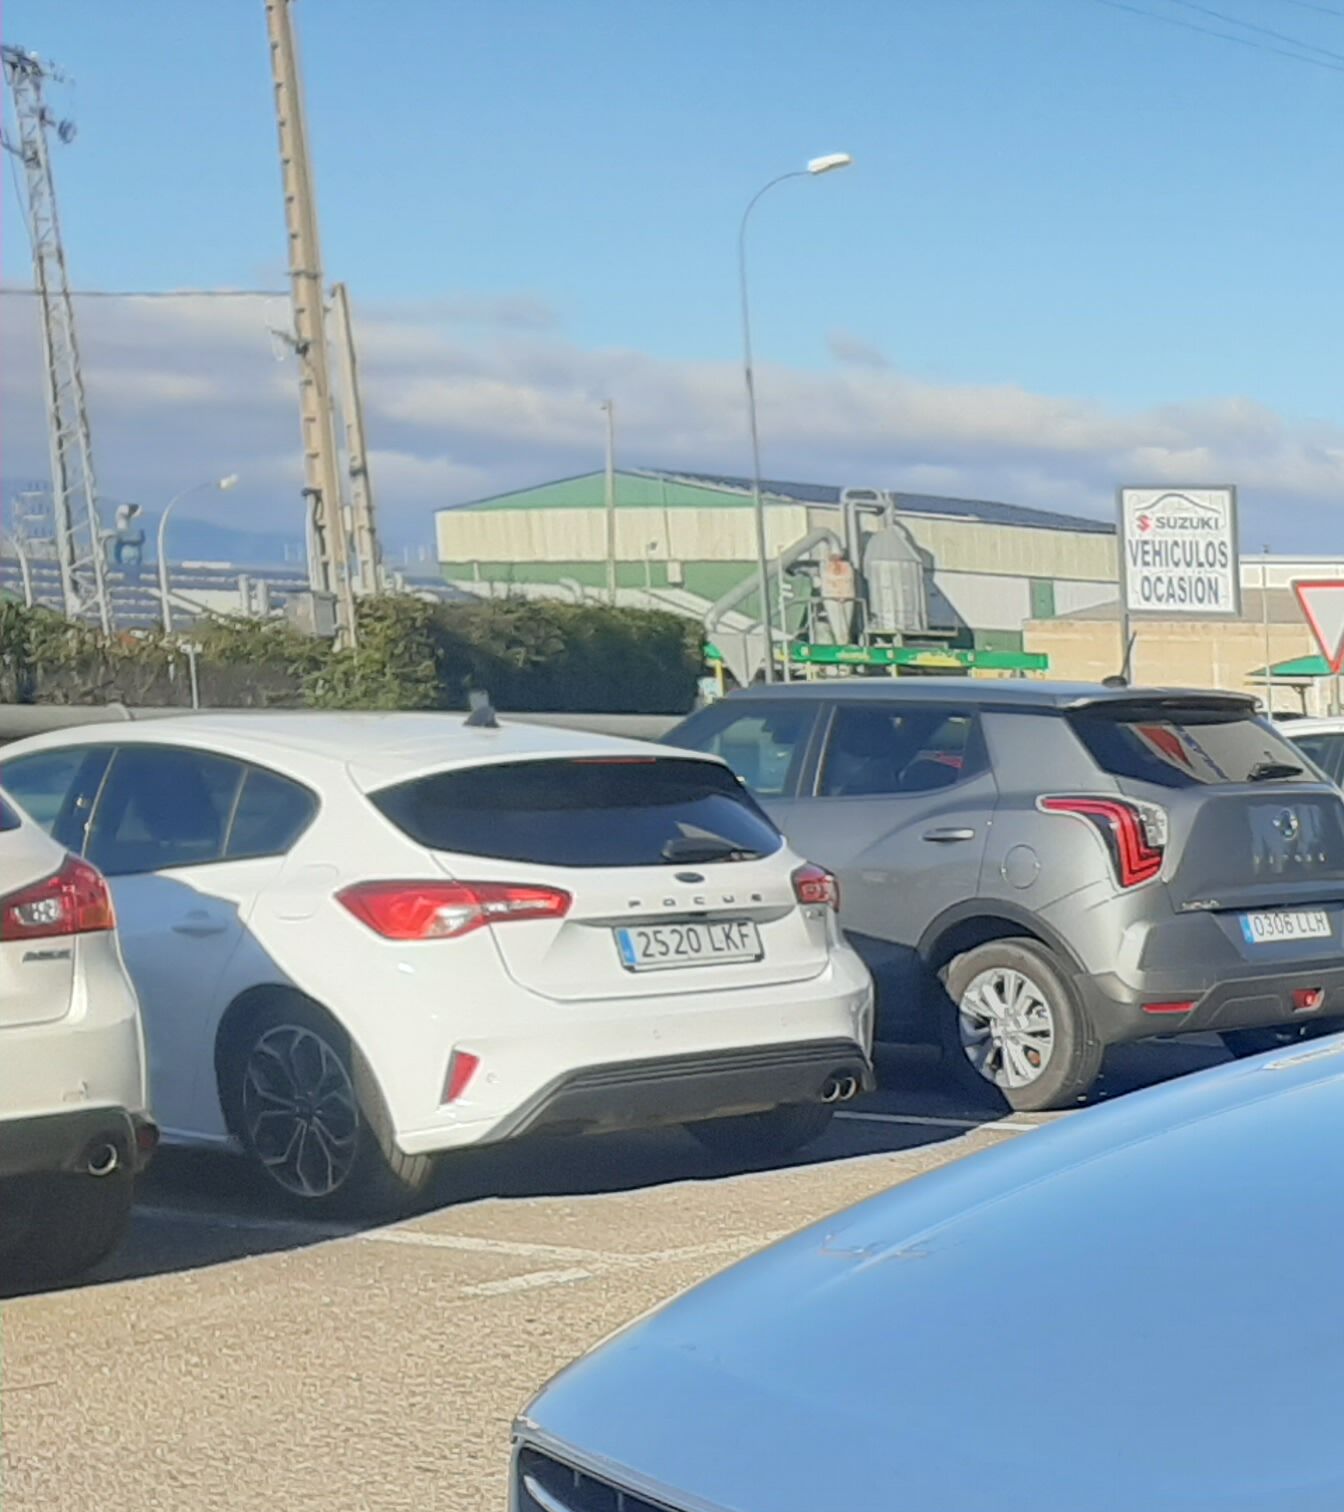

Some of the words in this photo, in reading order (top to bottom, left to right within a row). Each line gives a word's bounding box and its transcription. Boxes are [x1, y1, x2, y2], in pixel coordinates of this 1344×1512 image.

[1155, 516, 1219, 530] SUZUKI
[1128, 540, 1228, 568] VEHICULOS
[628, 893, 763, 907] FOCUS
[1253, 911, 1294, 937] 0306
[637, 927, 701, 958] 2520
[707, 922, 750, 952] LKF
